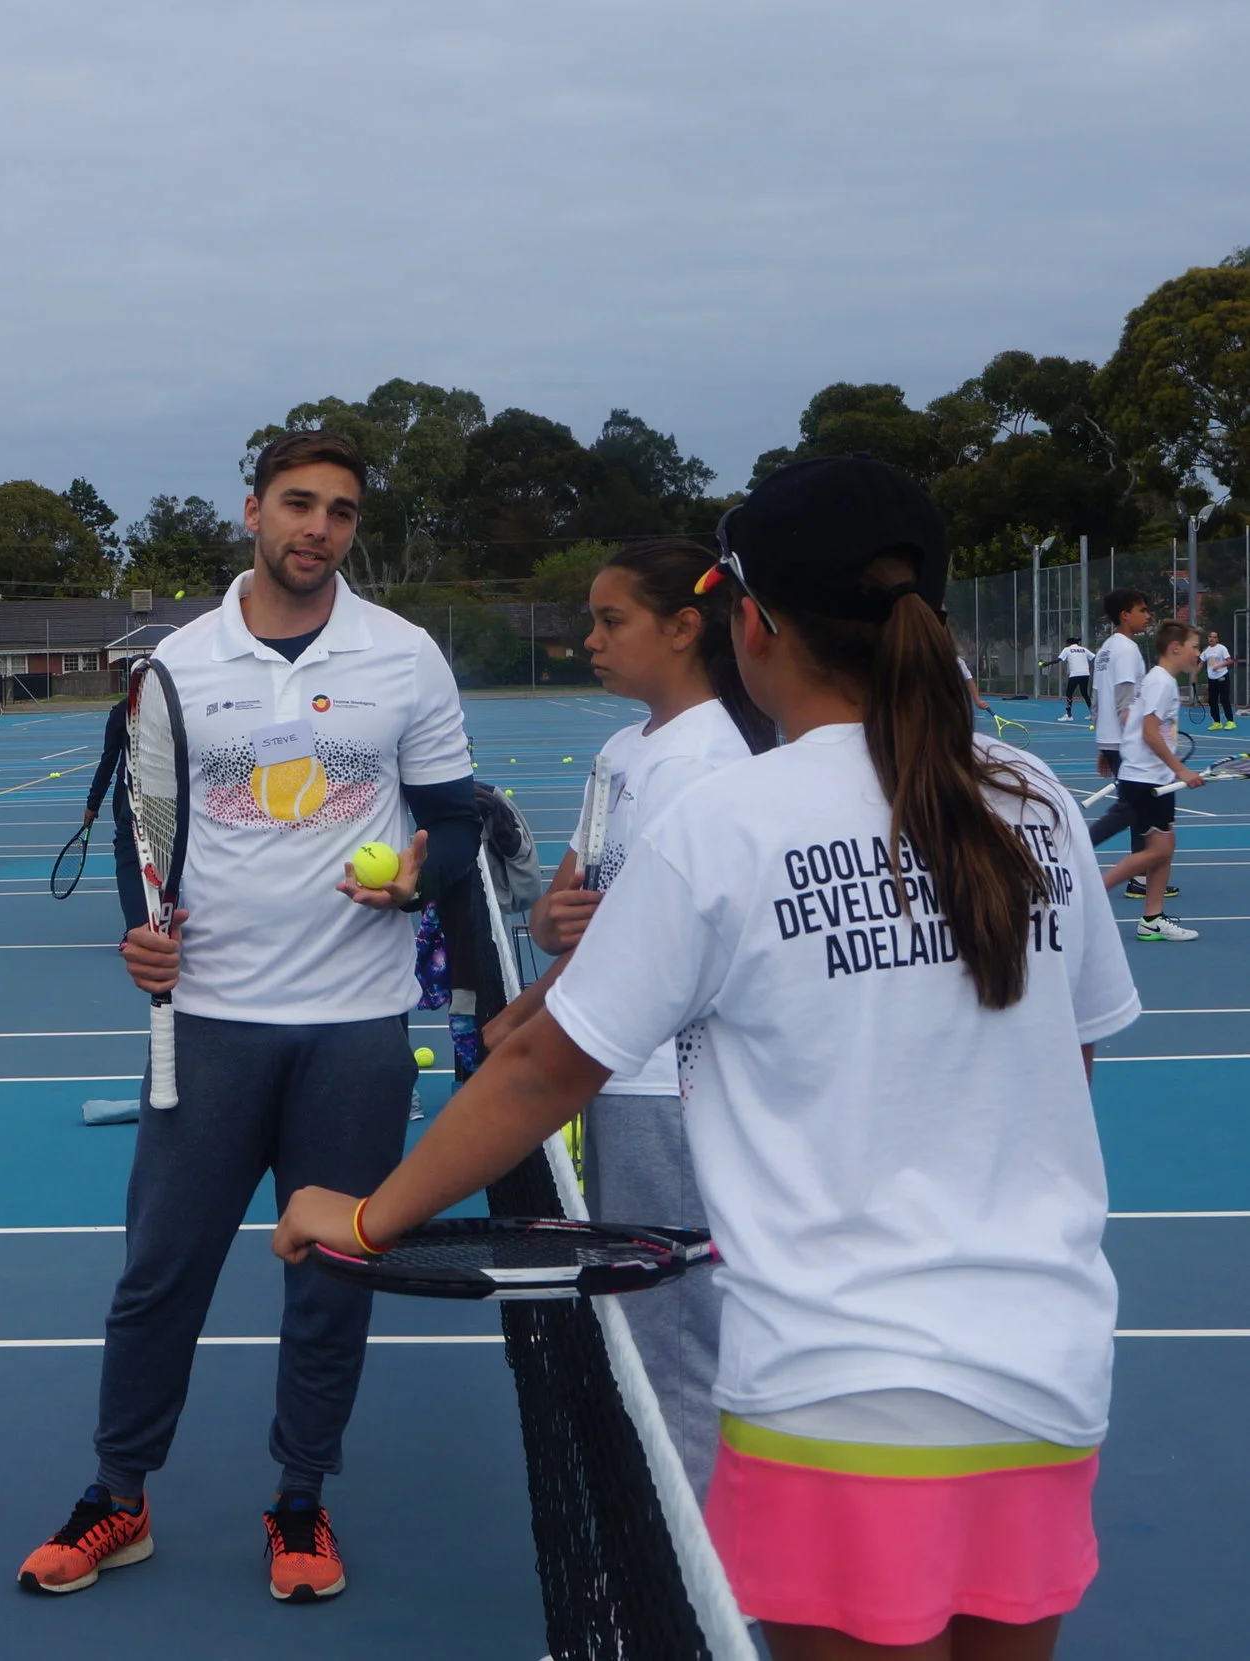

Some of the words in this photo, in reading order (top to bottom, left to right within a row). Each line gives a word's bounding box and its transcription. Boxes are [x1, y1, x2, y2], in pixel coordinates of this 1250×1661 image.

[262, 734, 298, 747] STEVE
[784, 835, 930, 890] GOOLAG
[158, 903, 173, 936] AD
[773, 875, 939, 940] DEVELOPM
[826, 920, 959, 979] ADELAID
[1029, 909, 1063, 952] 16
